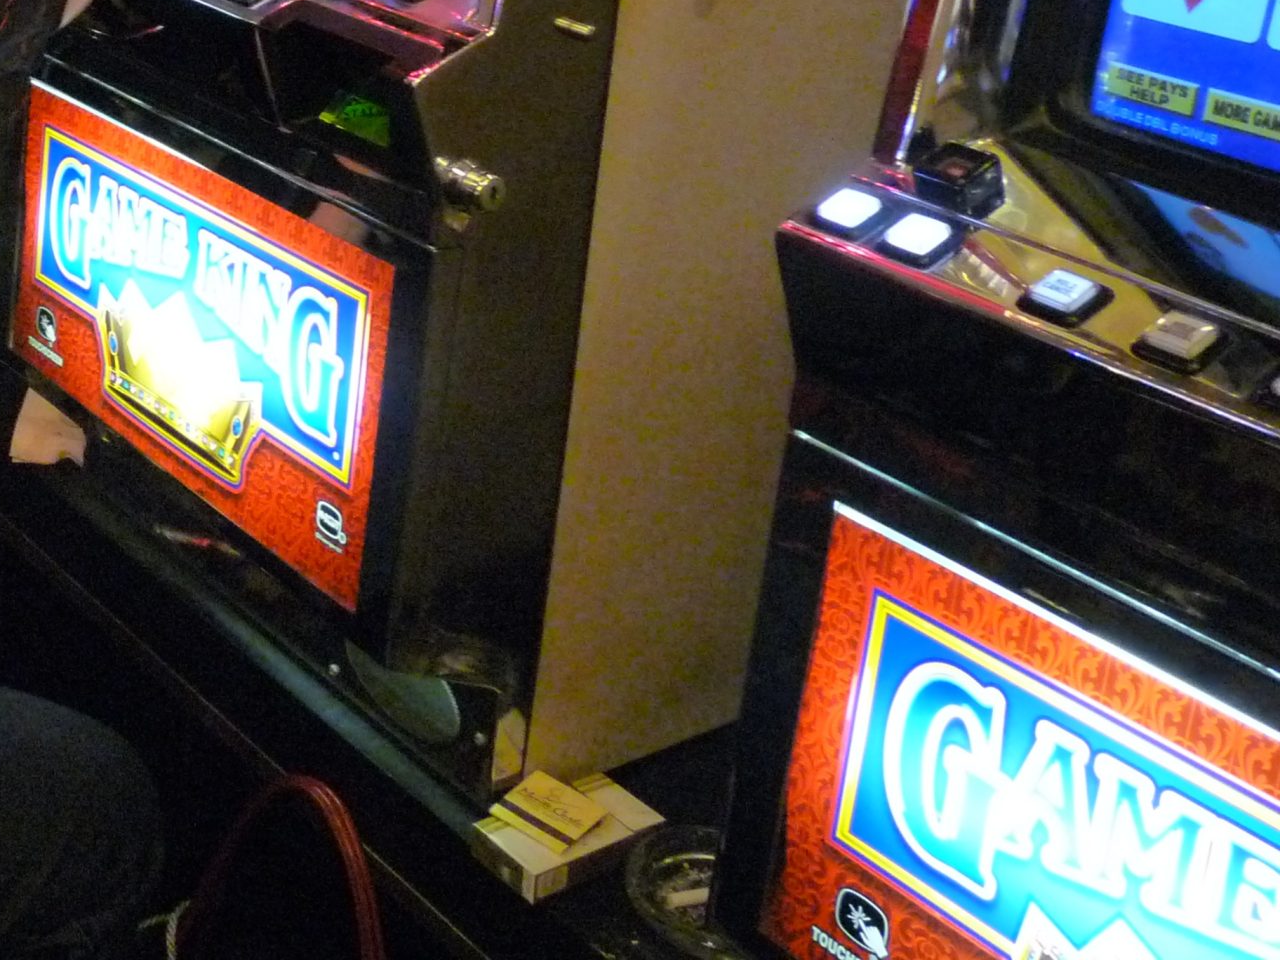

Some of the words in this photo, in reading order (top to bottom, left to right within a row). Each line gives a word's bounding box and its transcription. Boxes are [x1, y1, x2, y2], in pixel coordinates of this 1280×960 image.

[1130, 86, 1169, 105] HELP
[1148, 76, 1189, 99] PAYS
[1214, 99, 1251, 124] MORE
[1170, 123, 1218, 146] BONUS
[50, 157, 189, 289] GAME
[193, 228, 345, 446] KING
